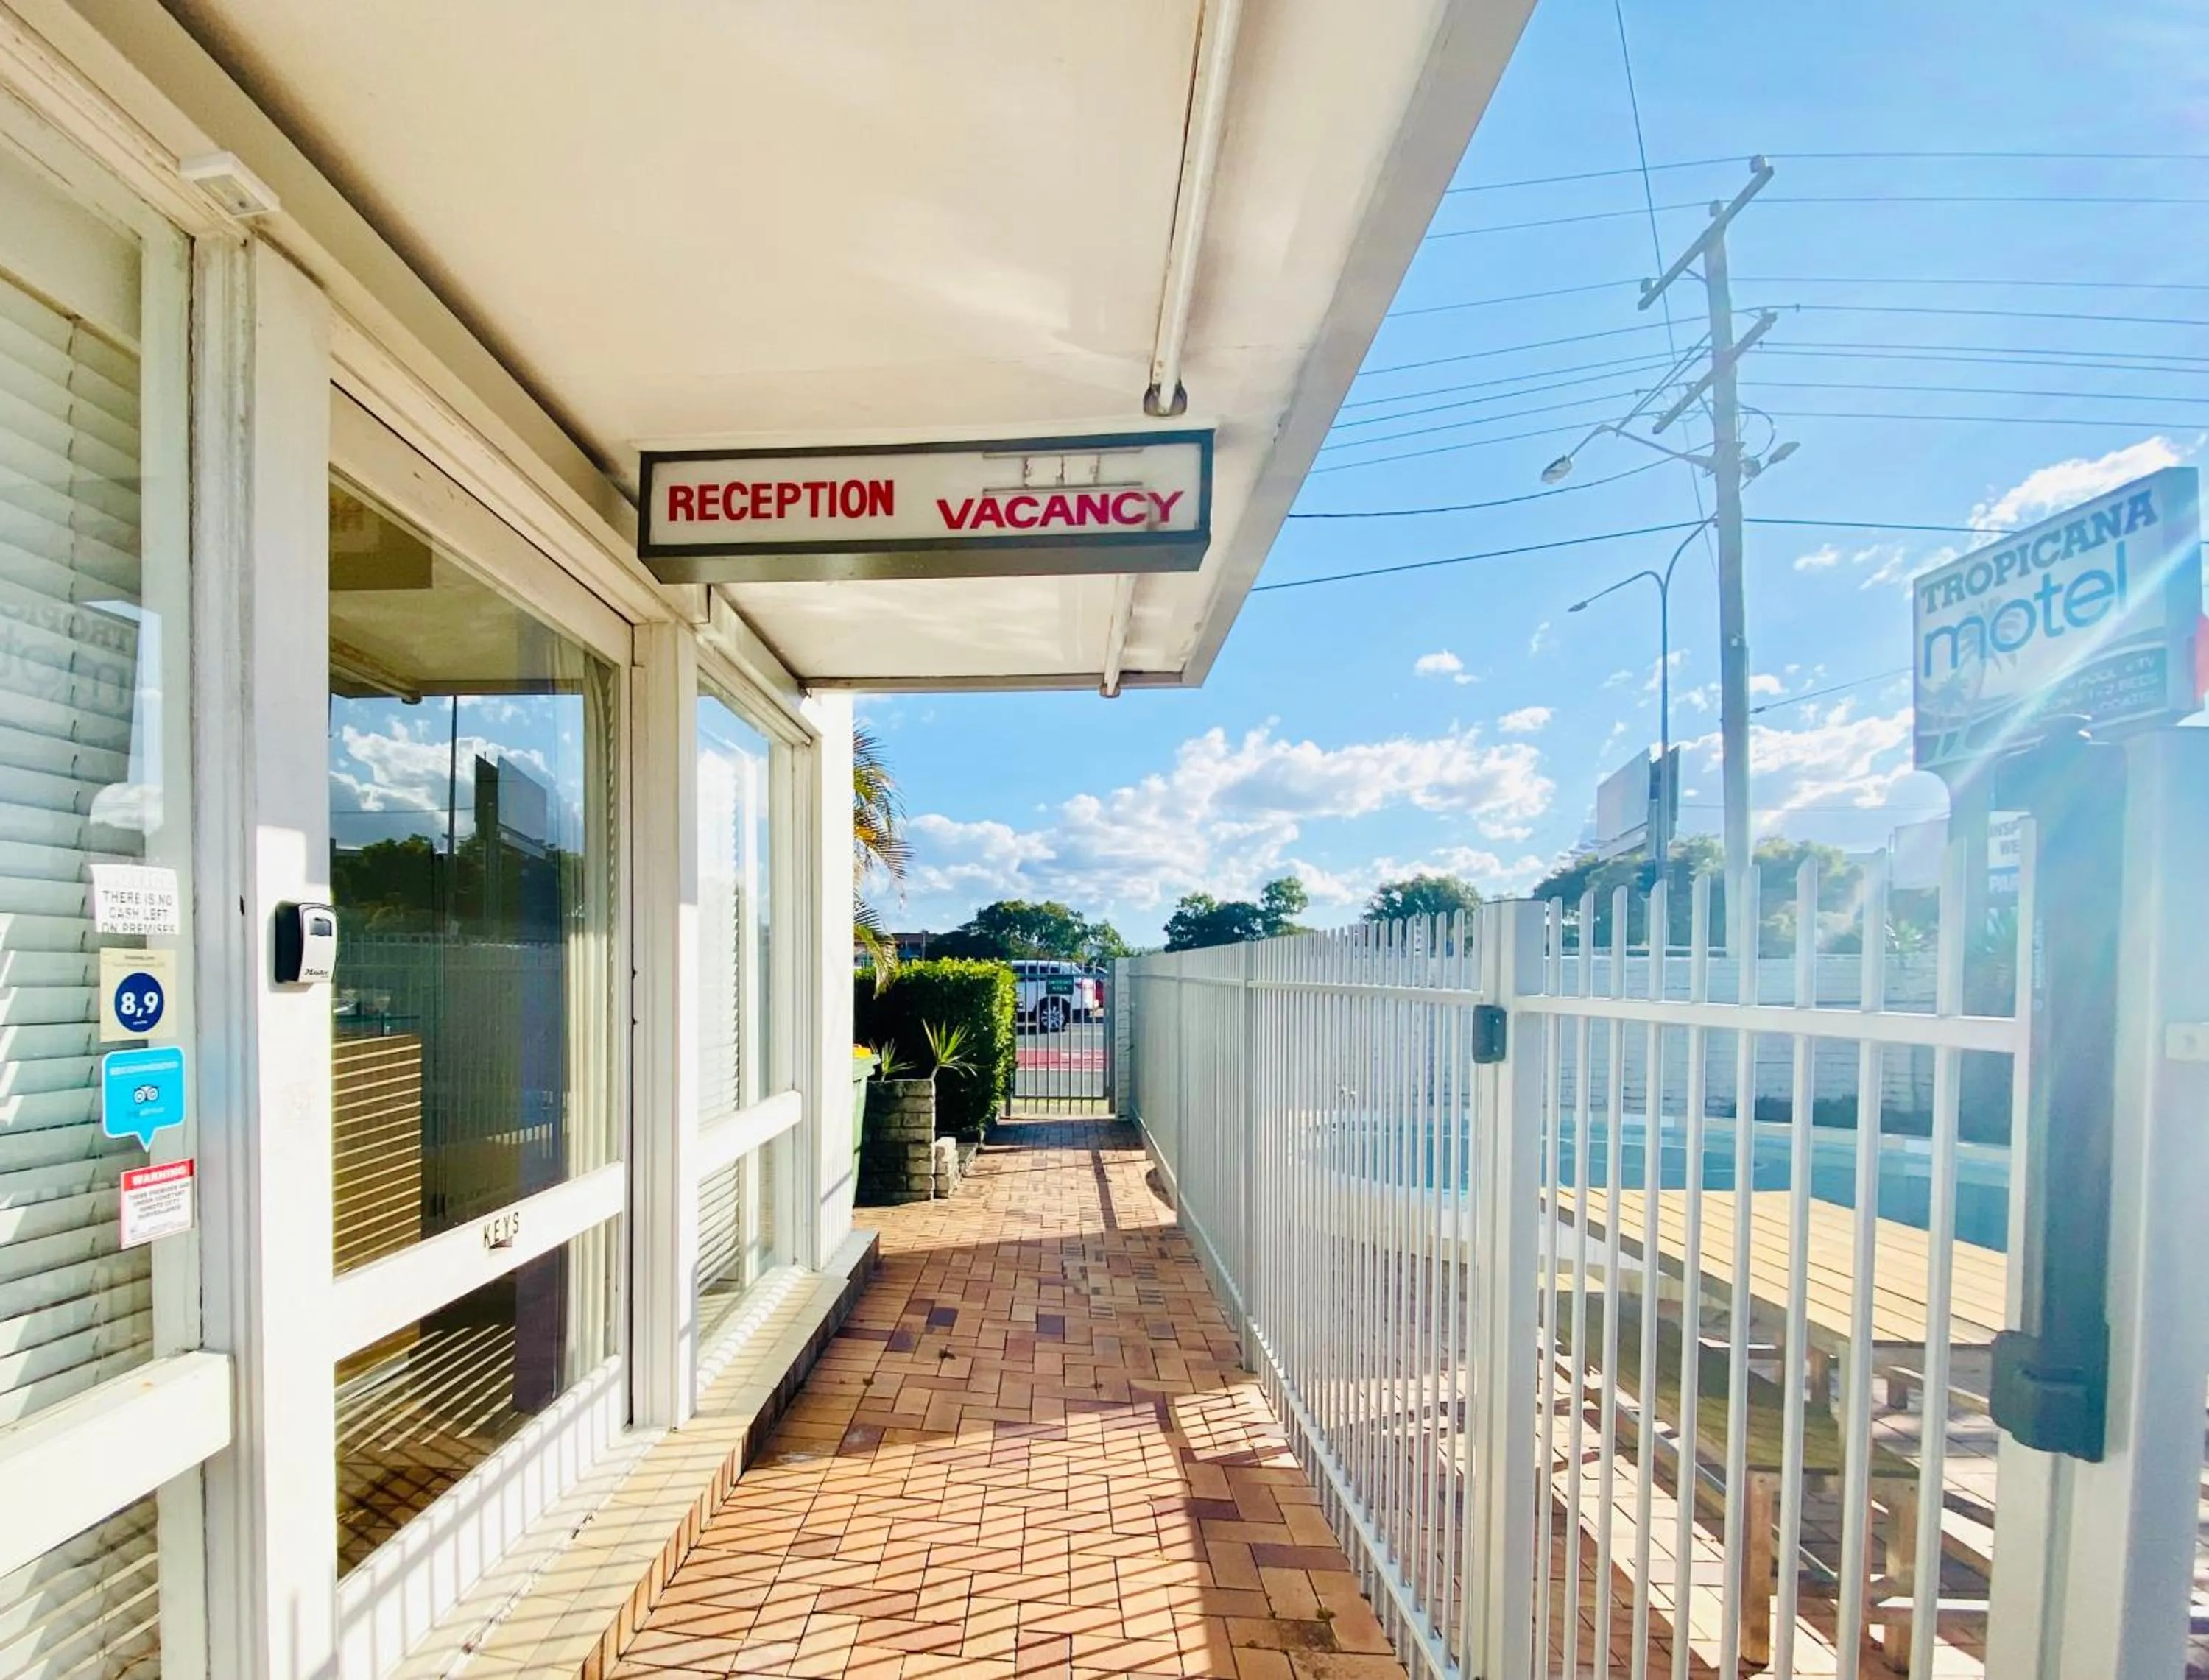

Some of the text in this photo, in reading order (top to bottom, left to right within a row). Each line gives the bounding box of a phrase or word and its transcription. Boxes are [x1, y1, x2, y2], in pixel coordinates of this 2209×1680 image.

[668, 479, 1185, 530] RECEPTION VACANCY
[1920, 490, 2159, 615] TROPICANA
[1923, 541, 2127, 678] motel
[102, 889, 172, 907] THERE IS NO
[102, 922, 175, 934] ON PREMISES
[109, 906, 169, 922] CASH LEFT
[121, 992, 159, 1018] 8,9
[483, 1211, 519, 1248] KEYS
